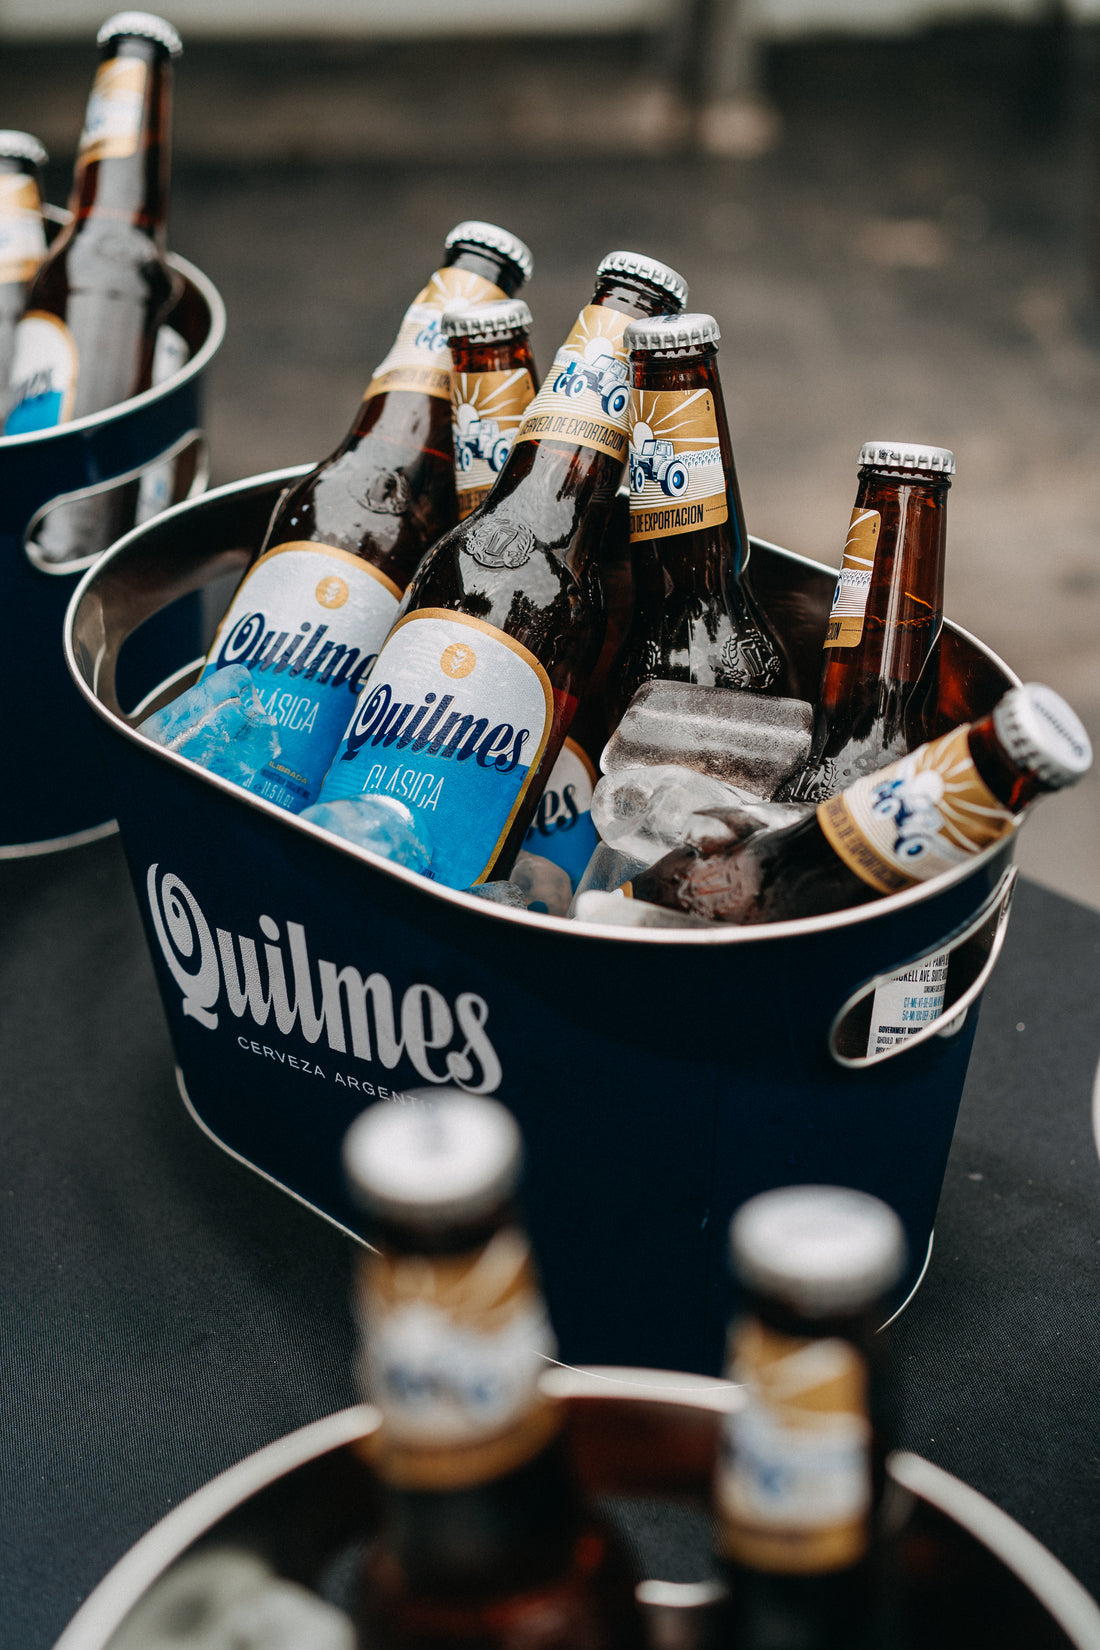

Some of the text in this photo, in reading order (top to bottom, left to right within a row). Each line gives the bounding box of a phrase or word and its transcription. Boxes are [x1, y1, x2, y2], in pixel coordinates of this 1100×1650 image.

[552, 417, 567, 433] DE
[566, 419, 626, 452] EXPORTACION
[644, 503, 704, 532] EXPORTACION
[217, 612, 378, 694] Quilme
[340, 683, 531, 776] Quilmes
[362, 764, 445, 812] CLÁSICA
[147, 862, 503, 1094] Quilmes
[878, 1025, 907, 1035] GOVERNMENT
[237, 1035, 326, 1079] CERVEZA
